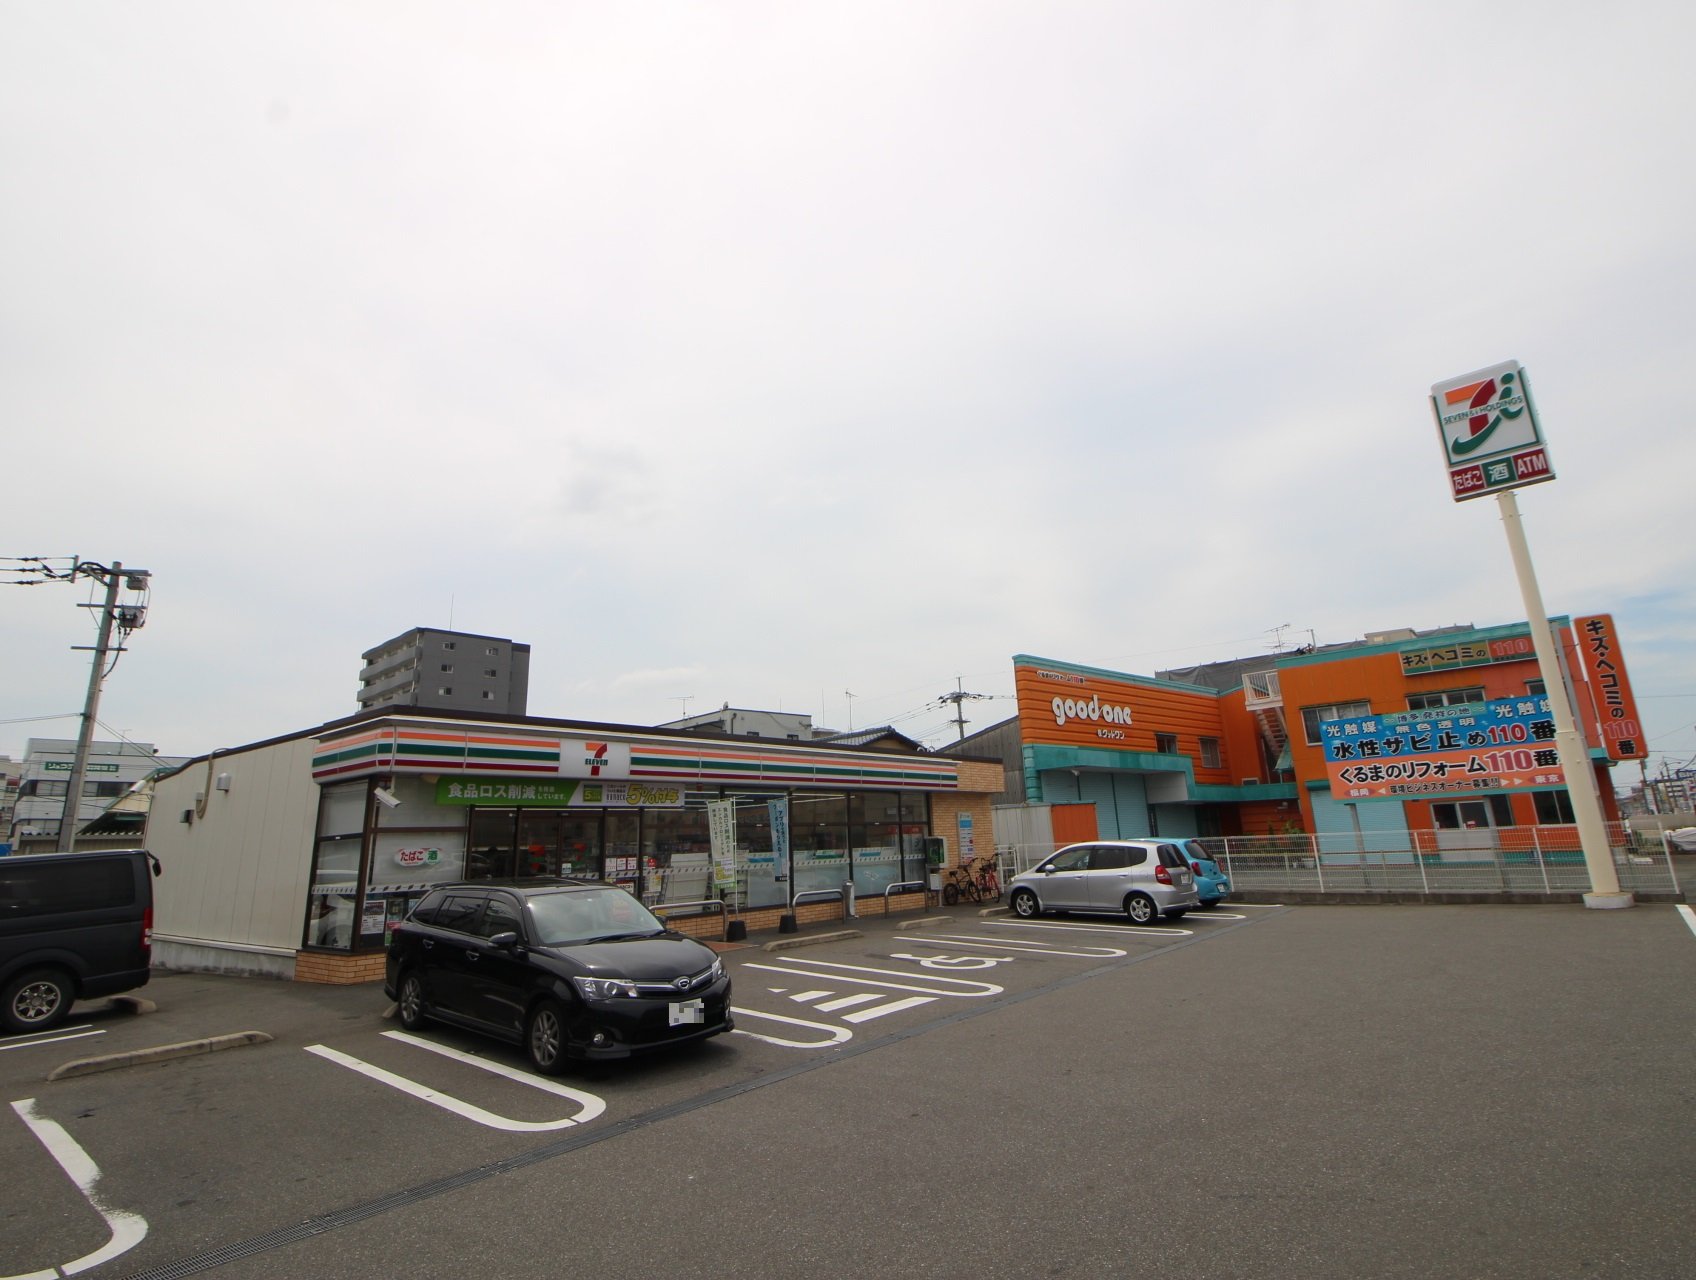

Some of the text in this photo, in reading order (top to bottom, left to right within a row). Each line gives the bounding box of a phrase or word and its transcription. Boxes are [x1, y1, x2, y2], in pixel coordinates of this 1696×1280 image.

[1480, 395, 1524, 413] HOLDINGS
[1488, 463, 1510, 483] 酒
[1517, 453, 1547, 476] ATM
[1453, 471, 1484, 490] たばこ
[1326, 721, 1377, 737] 光触媒
[447, 782, 537, 801] 食品ロス削減
[400, 850, 439, 862] たばこ 酒
